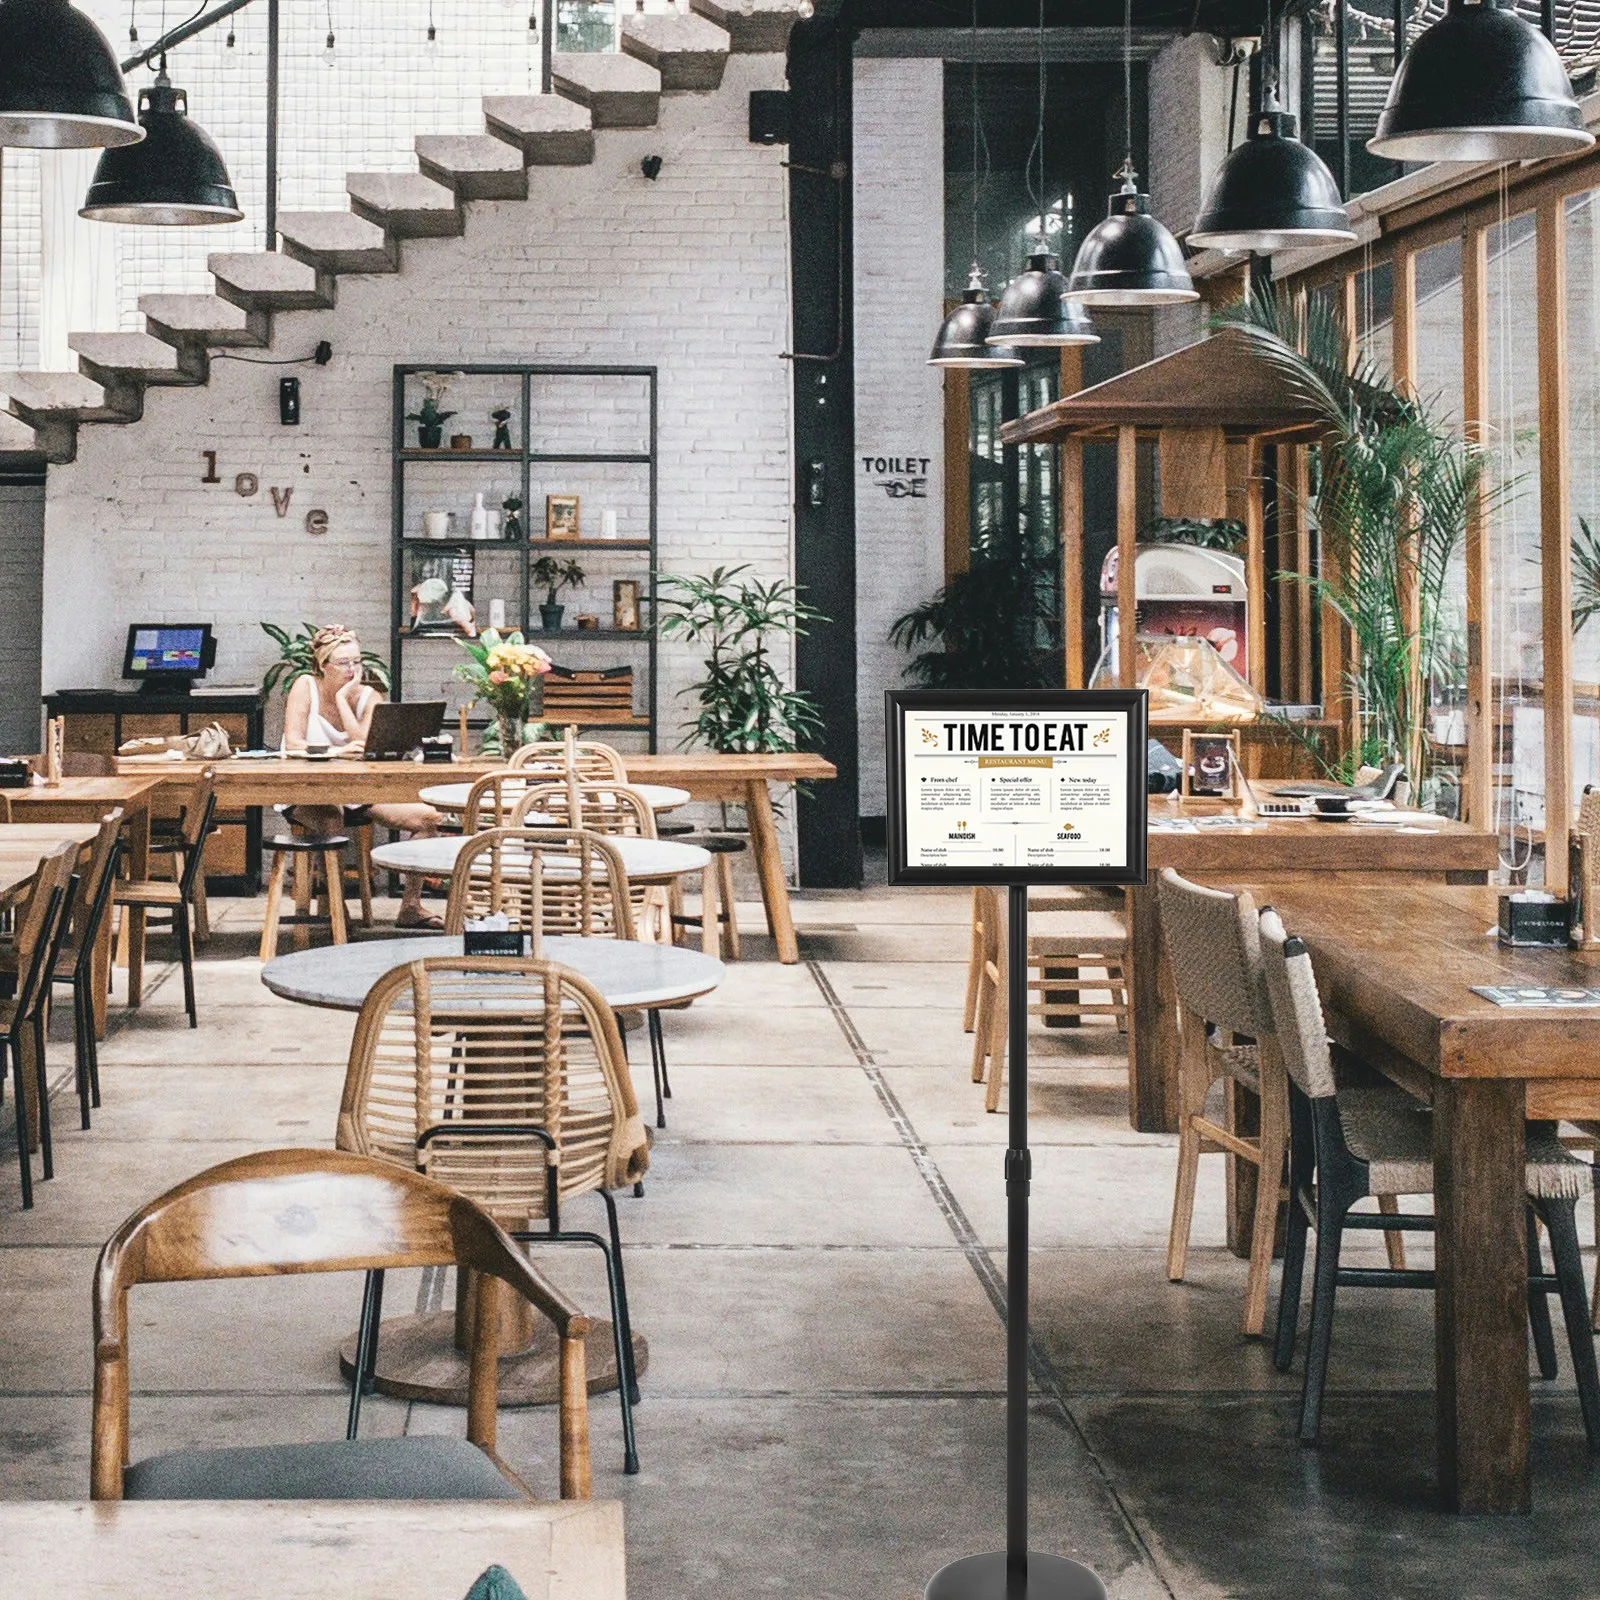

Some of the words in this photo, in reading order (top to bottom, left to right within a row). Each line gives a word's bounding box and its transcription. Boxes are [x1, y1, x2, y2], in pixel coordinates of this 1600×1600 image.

[862, 457, 931, 474] TOILET
[201, 450, 329, 535] love
[943, 723, 1004, 752] TIME
[1008, 723, 1040, 752] TO
[1044, 723, 1088, 752] EAT
